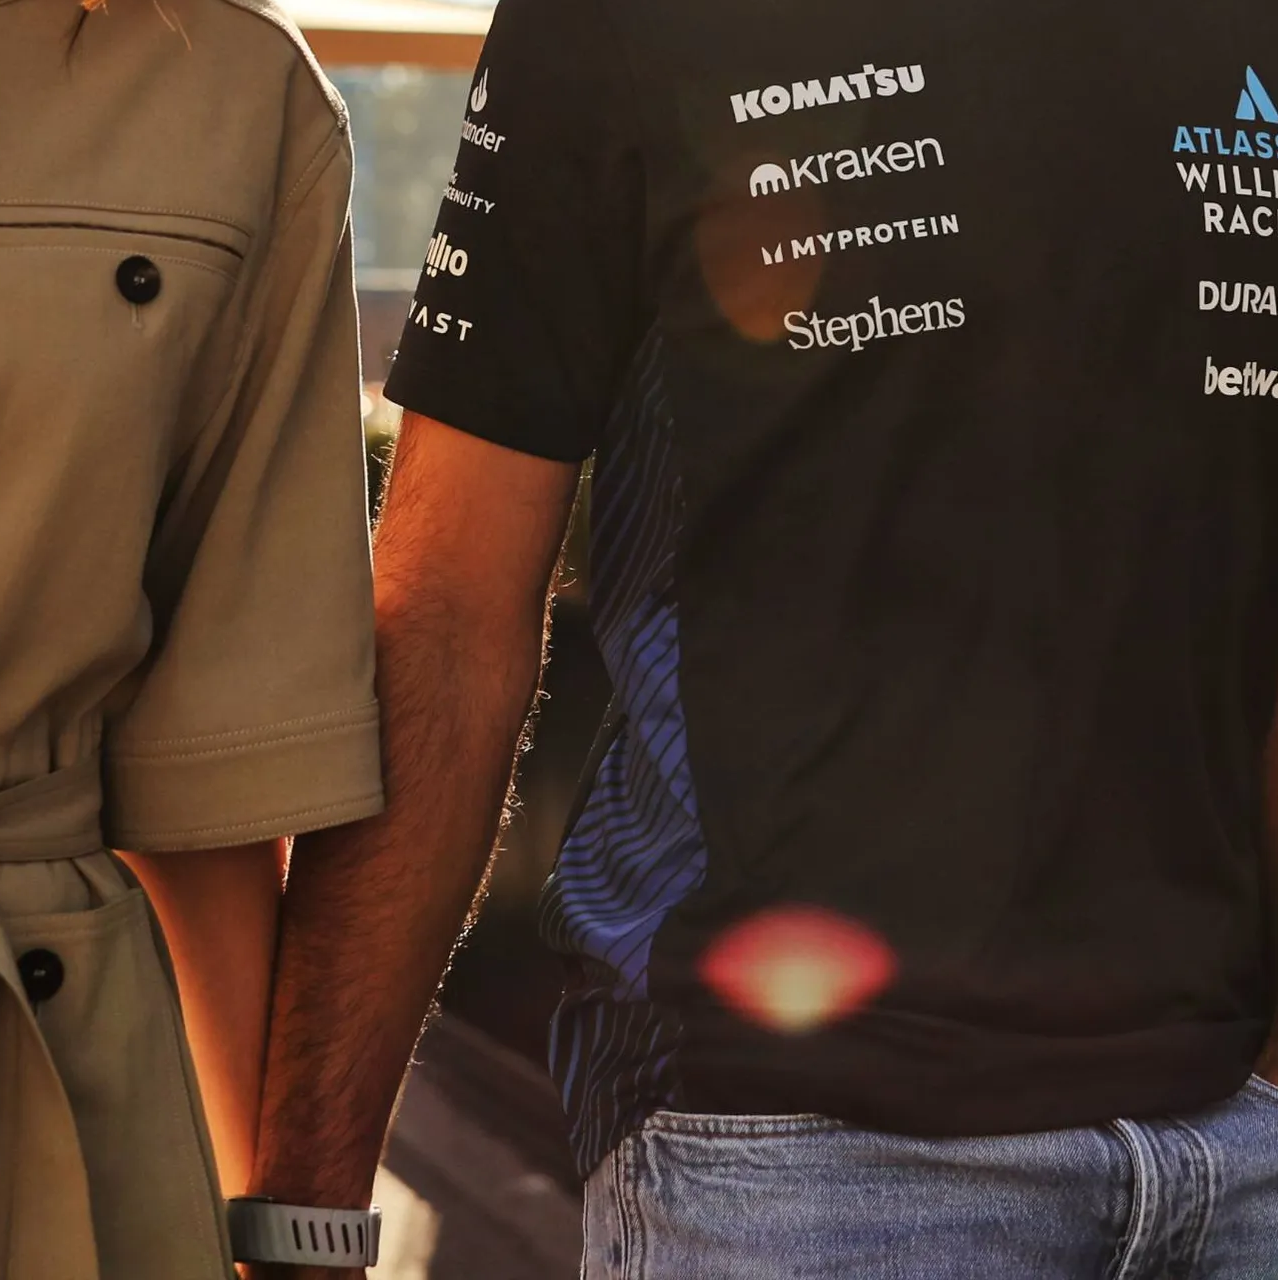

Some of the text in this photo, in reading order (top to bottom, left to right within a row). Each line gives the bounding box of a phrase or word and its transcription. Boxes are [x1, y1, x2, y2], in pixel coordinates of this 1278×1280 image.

[730, 63, 926, 123] KOMATSU
[789, 137, 945, 188] kraken
[790, 214, 959, 260] MYPROTEIN
[783, 295, 966, 352] Stephens
